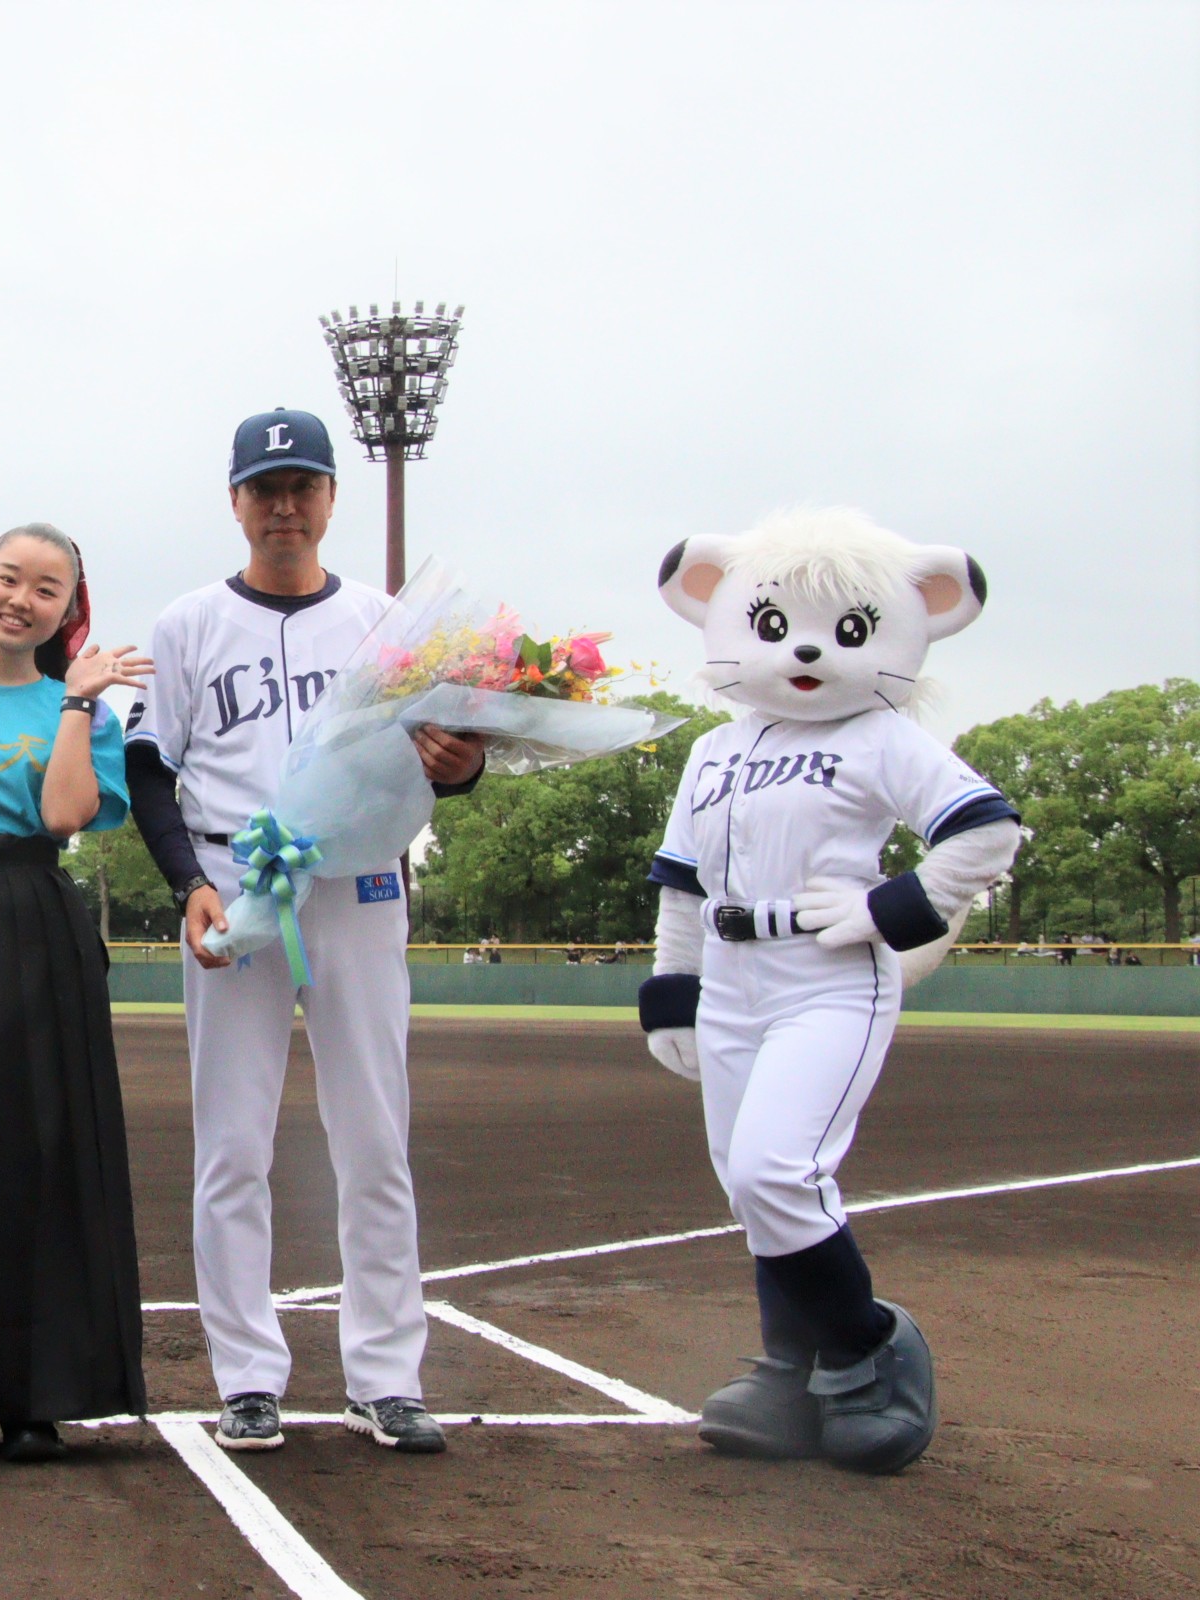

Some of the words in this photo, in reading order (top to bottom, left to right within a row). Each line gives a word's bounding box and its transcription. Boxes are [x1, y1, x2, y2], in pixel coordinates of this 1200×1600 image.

[265, 423, 293, 451] L
[207, 656, 337, 737] Lio
[369, 889, 393, 900] SOGO
